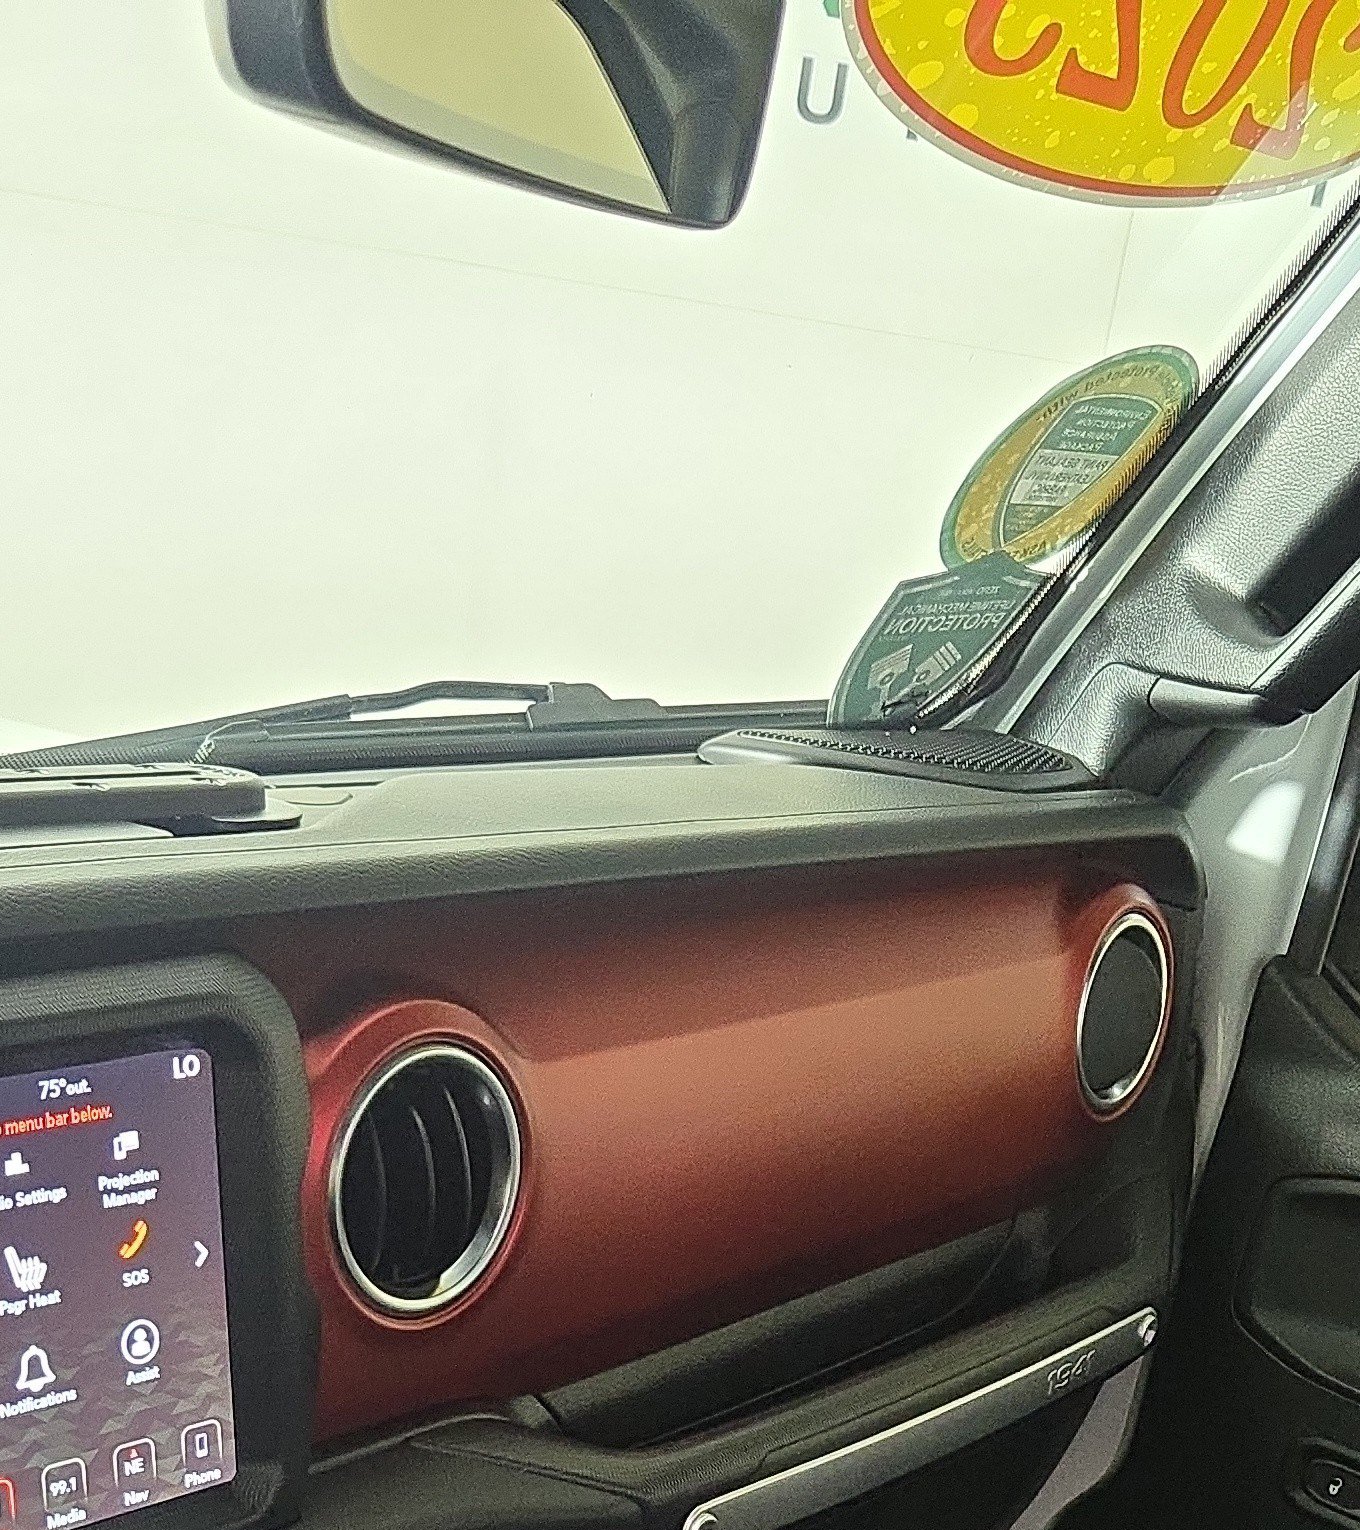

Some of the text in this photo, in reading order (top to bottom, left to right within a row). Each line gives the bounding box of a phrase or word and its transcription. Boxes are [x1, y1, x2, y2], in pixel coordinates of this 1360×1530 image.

[172, 1054, 201, 1080] LO
[5, 1115, 44, 1136] menu
[46, 1110, 69, 1129] bar
[71, 1104, 113, 1125] below.
[97, 1168, 160, 1192] Projection
[15, 1185, 68, 1208] Settings
[102, 1187, 158, 1209] Manager
[122, 1268, 150, 1288] SOS
[28, 1290, 62, 1309] Heat
[125, 1365, 161, 1386] Assist
[124, 1457, 145, 1477] NE
[49, 1476, 77, 1497] 99.1
[184, 1467, 222, 1490] Phone
[124, 1488, 150, 1507] Nav
[46, 1507, 87, 1530] Media
